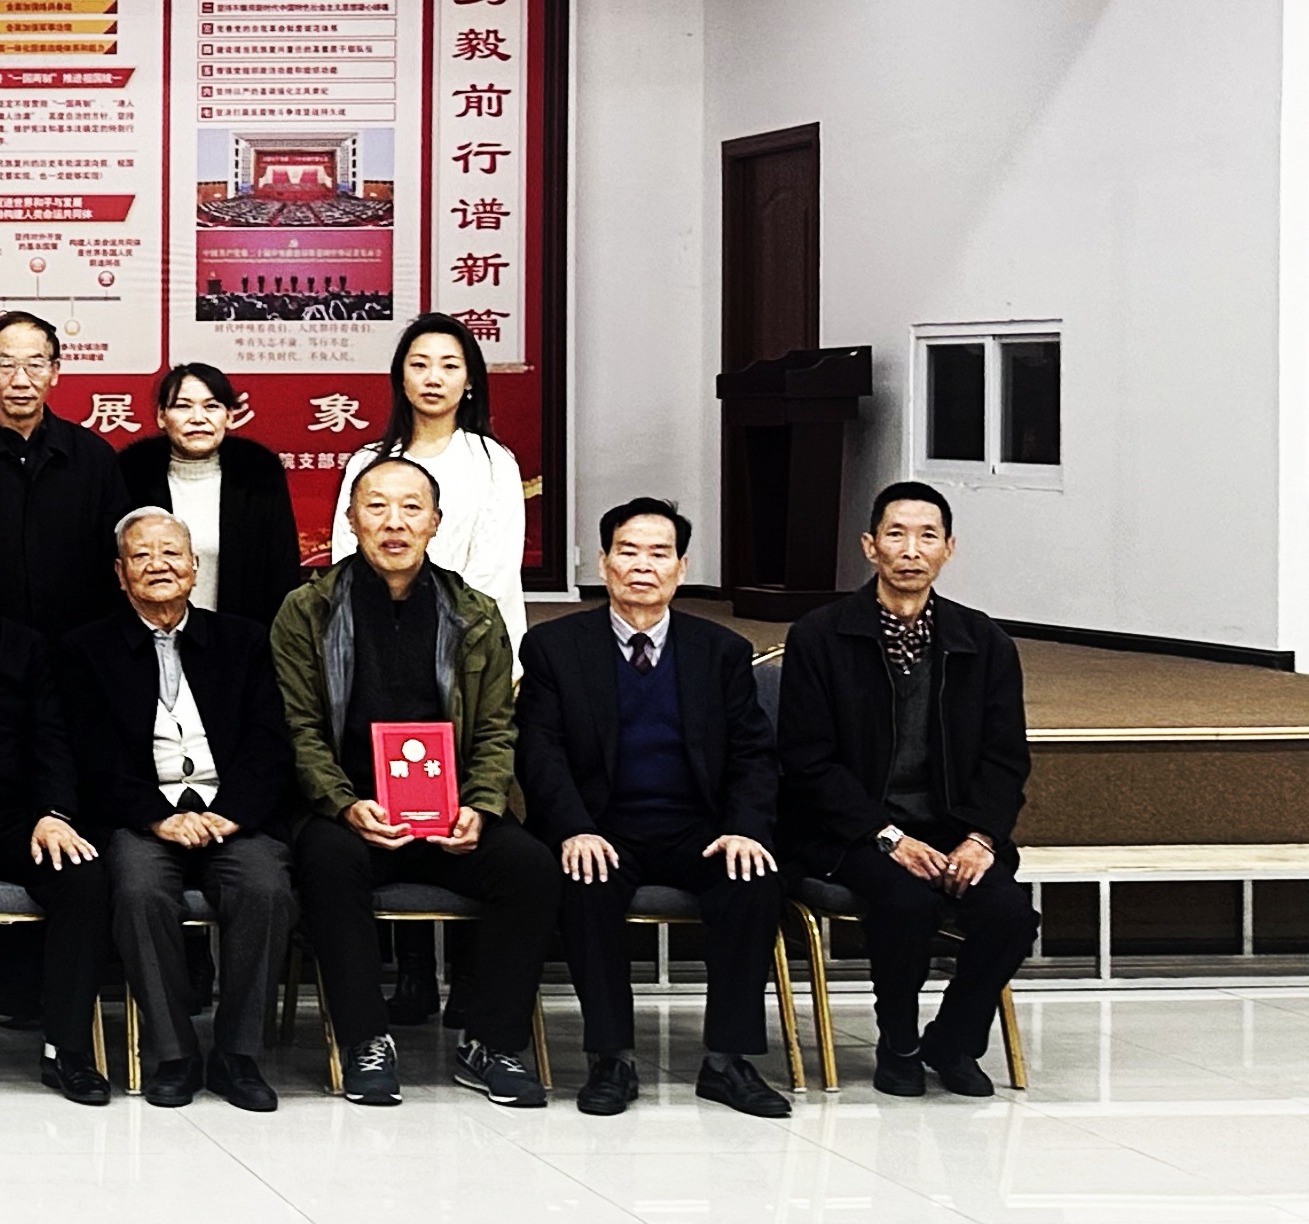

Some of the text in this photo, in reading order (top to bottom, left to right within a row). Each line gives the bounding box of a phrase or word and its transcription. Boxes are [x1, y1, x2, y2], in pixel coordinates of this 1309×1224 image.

[449, 0, 512, 343] 毅前行谱新篇
[82, 393, 142, 433] 展
[307, 393, 369, 433] 象
